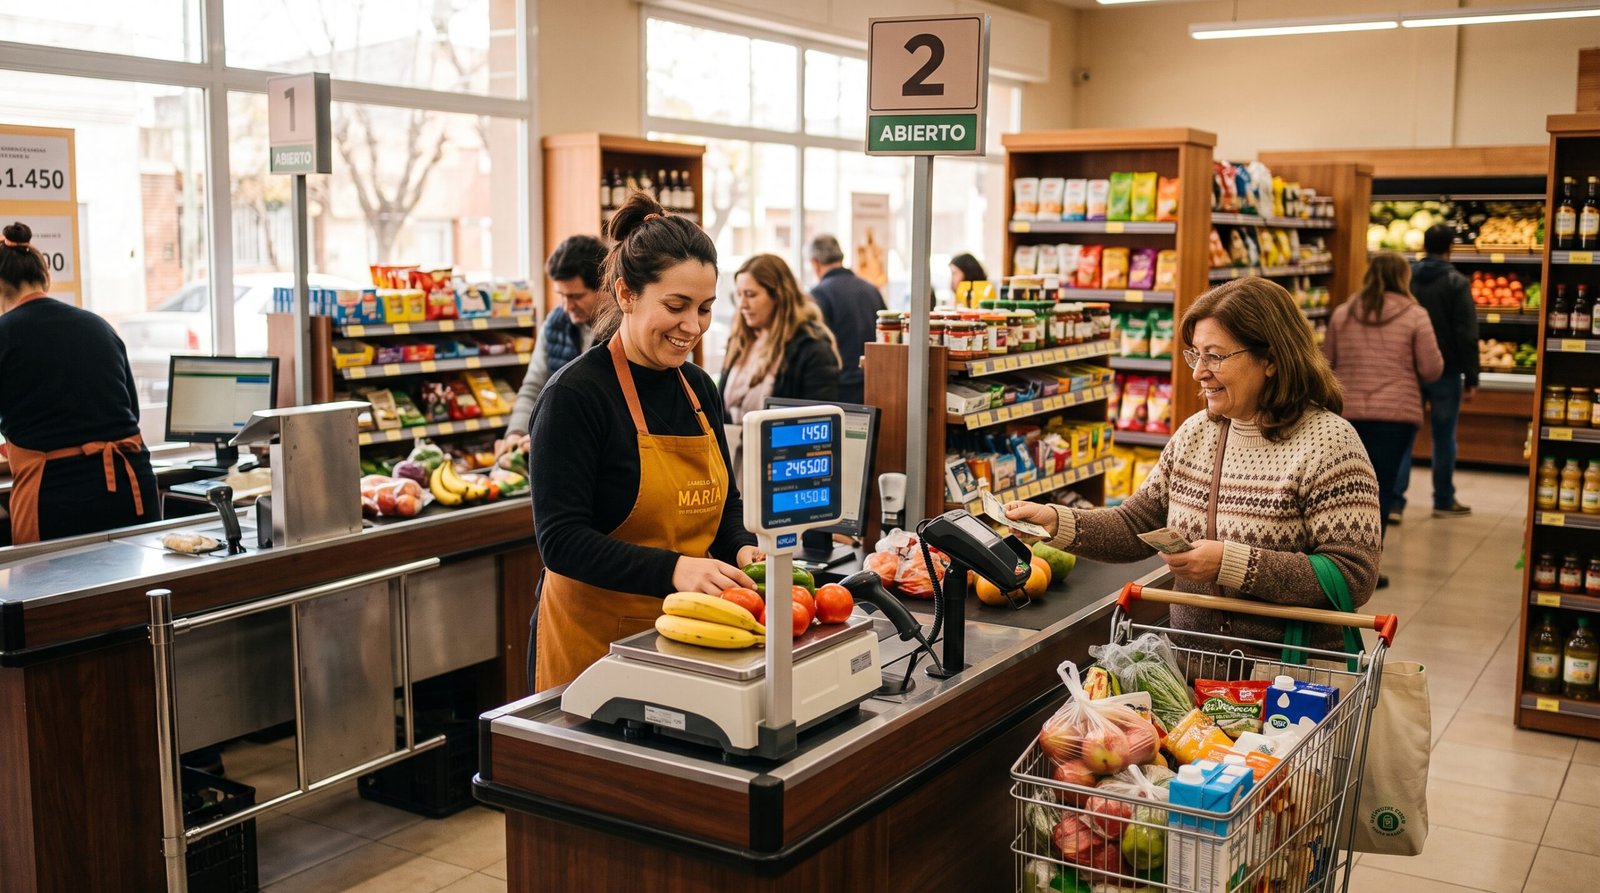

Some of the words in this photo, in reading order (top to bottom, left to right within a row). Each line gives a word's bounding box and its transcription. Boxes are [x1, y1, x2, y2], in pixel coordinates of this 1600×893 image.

[902, 33, 946, 97] 2
[284, 87, 296, 132] 1
[879, 124, 966, 142] ABIERTO
[274, 151, 312, 167] ABIERTO
[0, 167, 64, 190] 1.450
[802, 424, 828, 440] 1450
